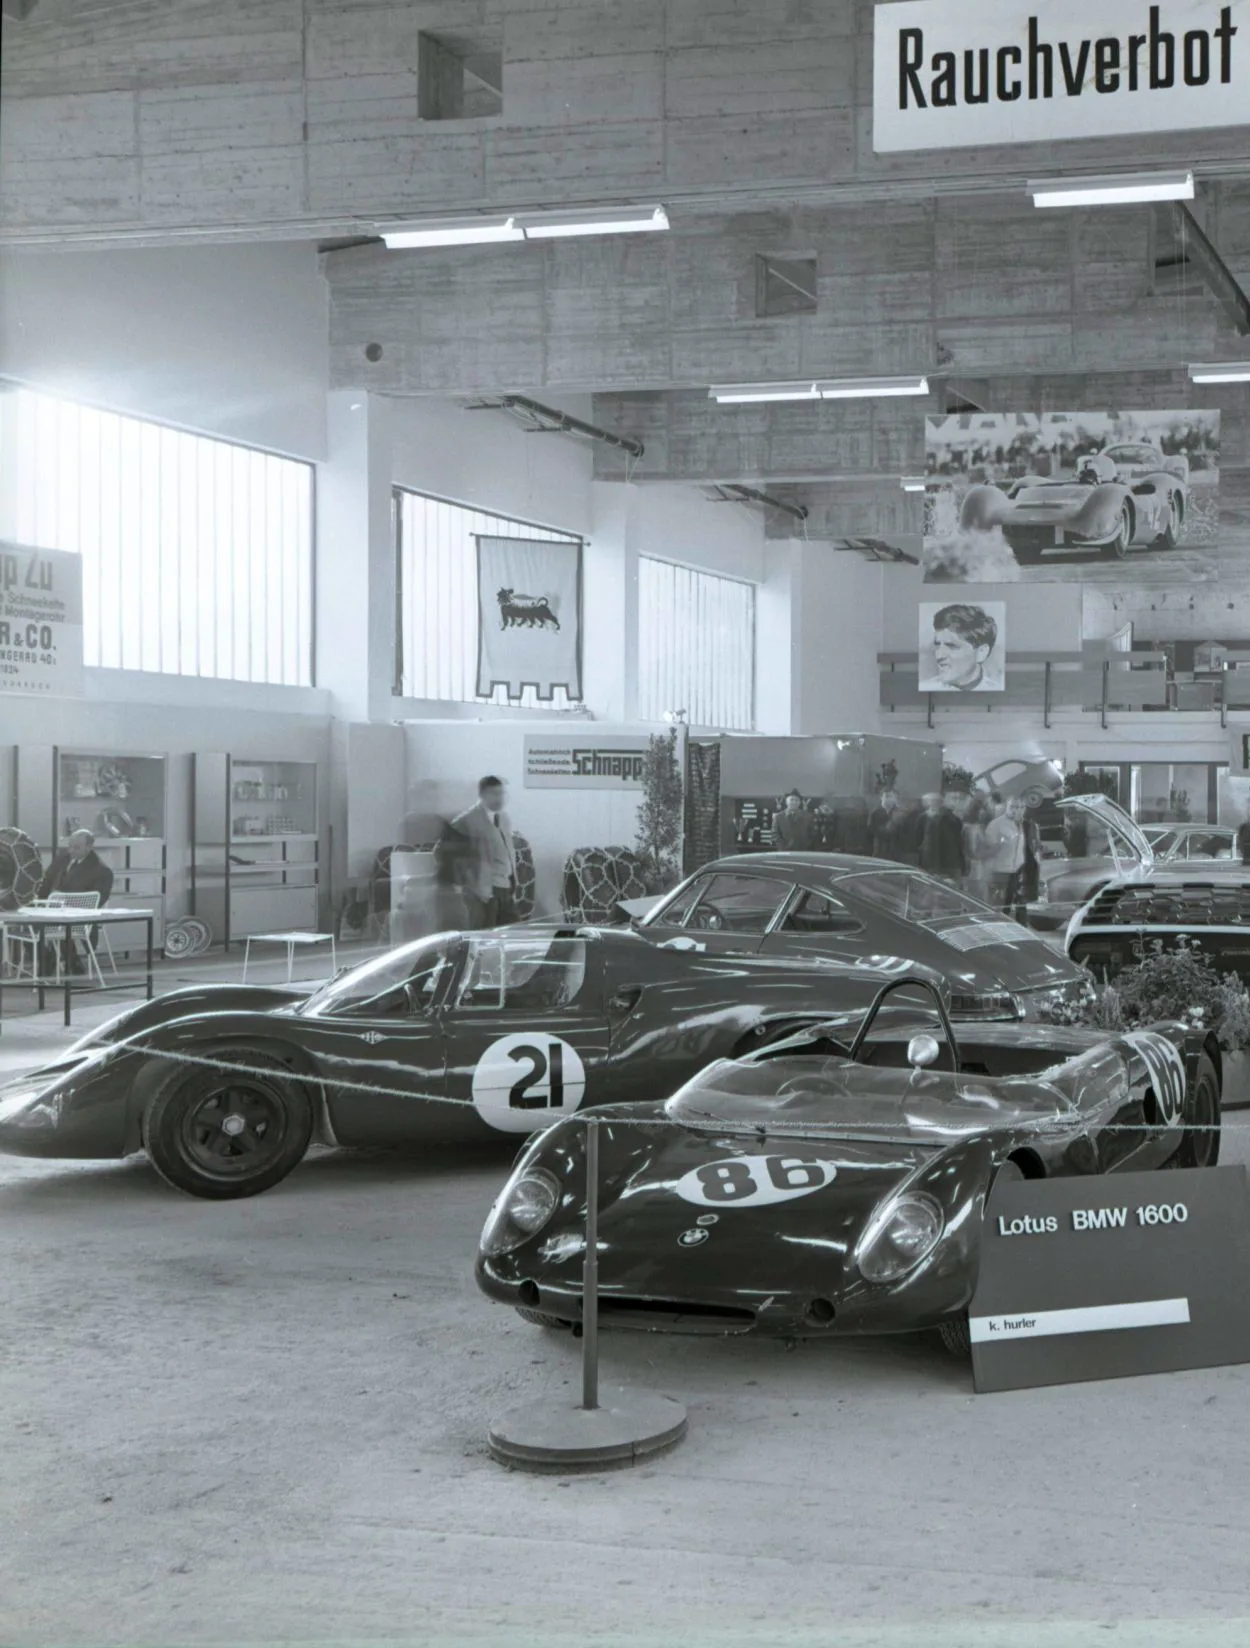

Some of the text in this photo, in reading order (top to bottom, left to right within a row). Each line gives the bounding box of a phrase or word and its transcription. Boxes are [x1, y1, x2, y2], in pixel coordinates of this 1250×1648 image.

[507, 1043, 564, 1110] 21
[696, 1155, 826, 1202] 86
[999, 1202, 1188, 1236] Lotus BMW 1600
[989, 1318, 1037, 1331] k. hurler
